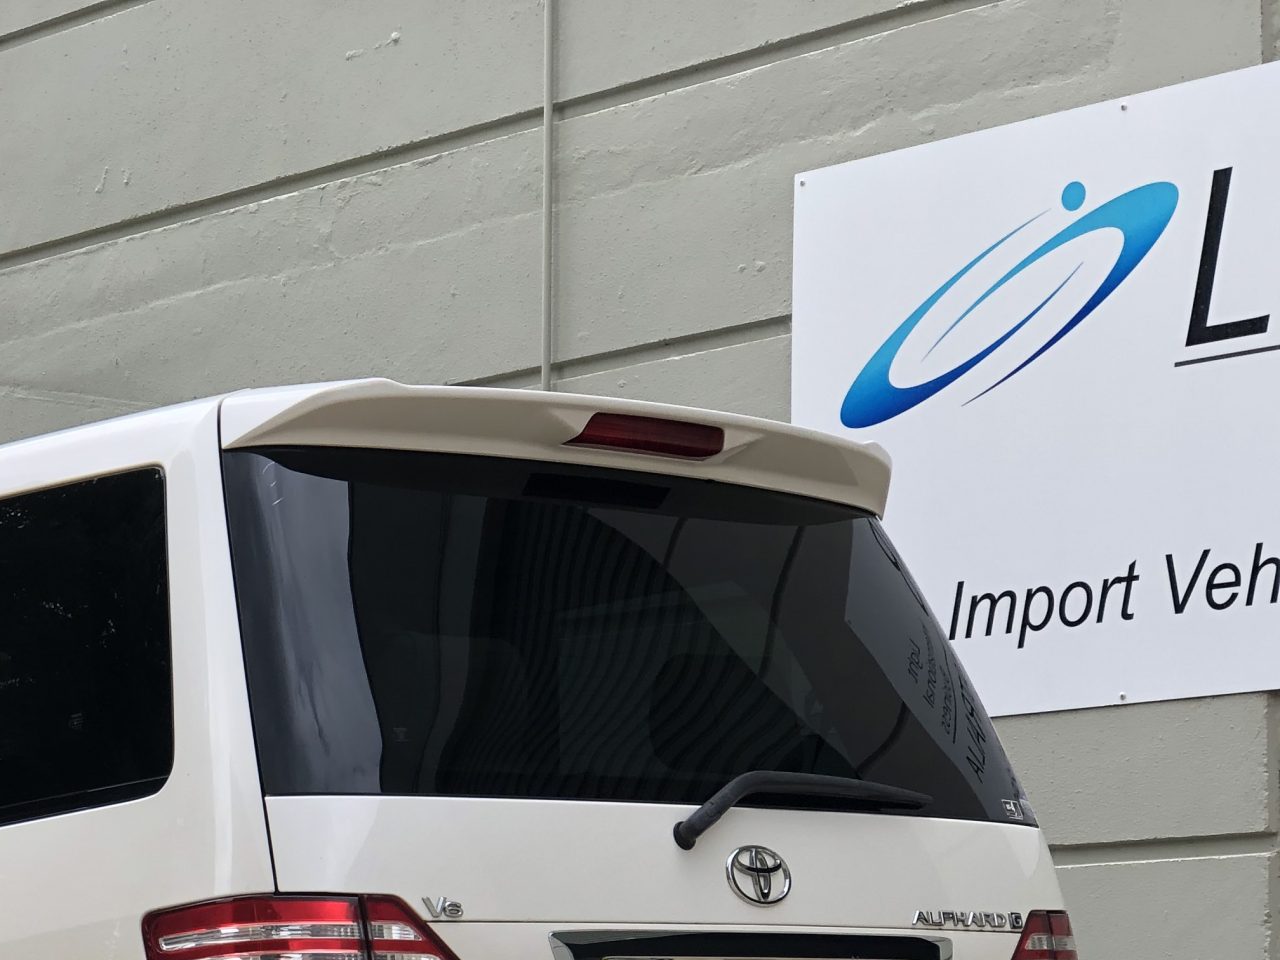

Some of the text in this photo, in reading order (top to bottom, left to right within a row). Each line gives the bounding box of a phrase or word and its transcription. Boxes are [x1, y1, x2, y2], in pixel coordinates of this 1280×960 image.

[948, 542, 1280, 649] Import Veh
[421, 896, 464, 919] V6
[912, 910, 1007, 928] ALPHARD
